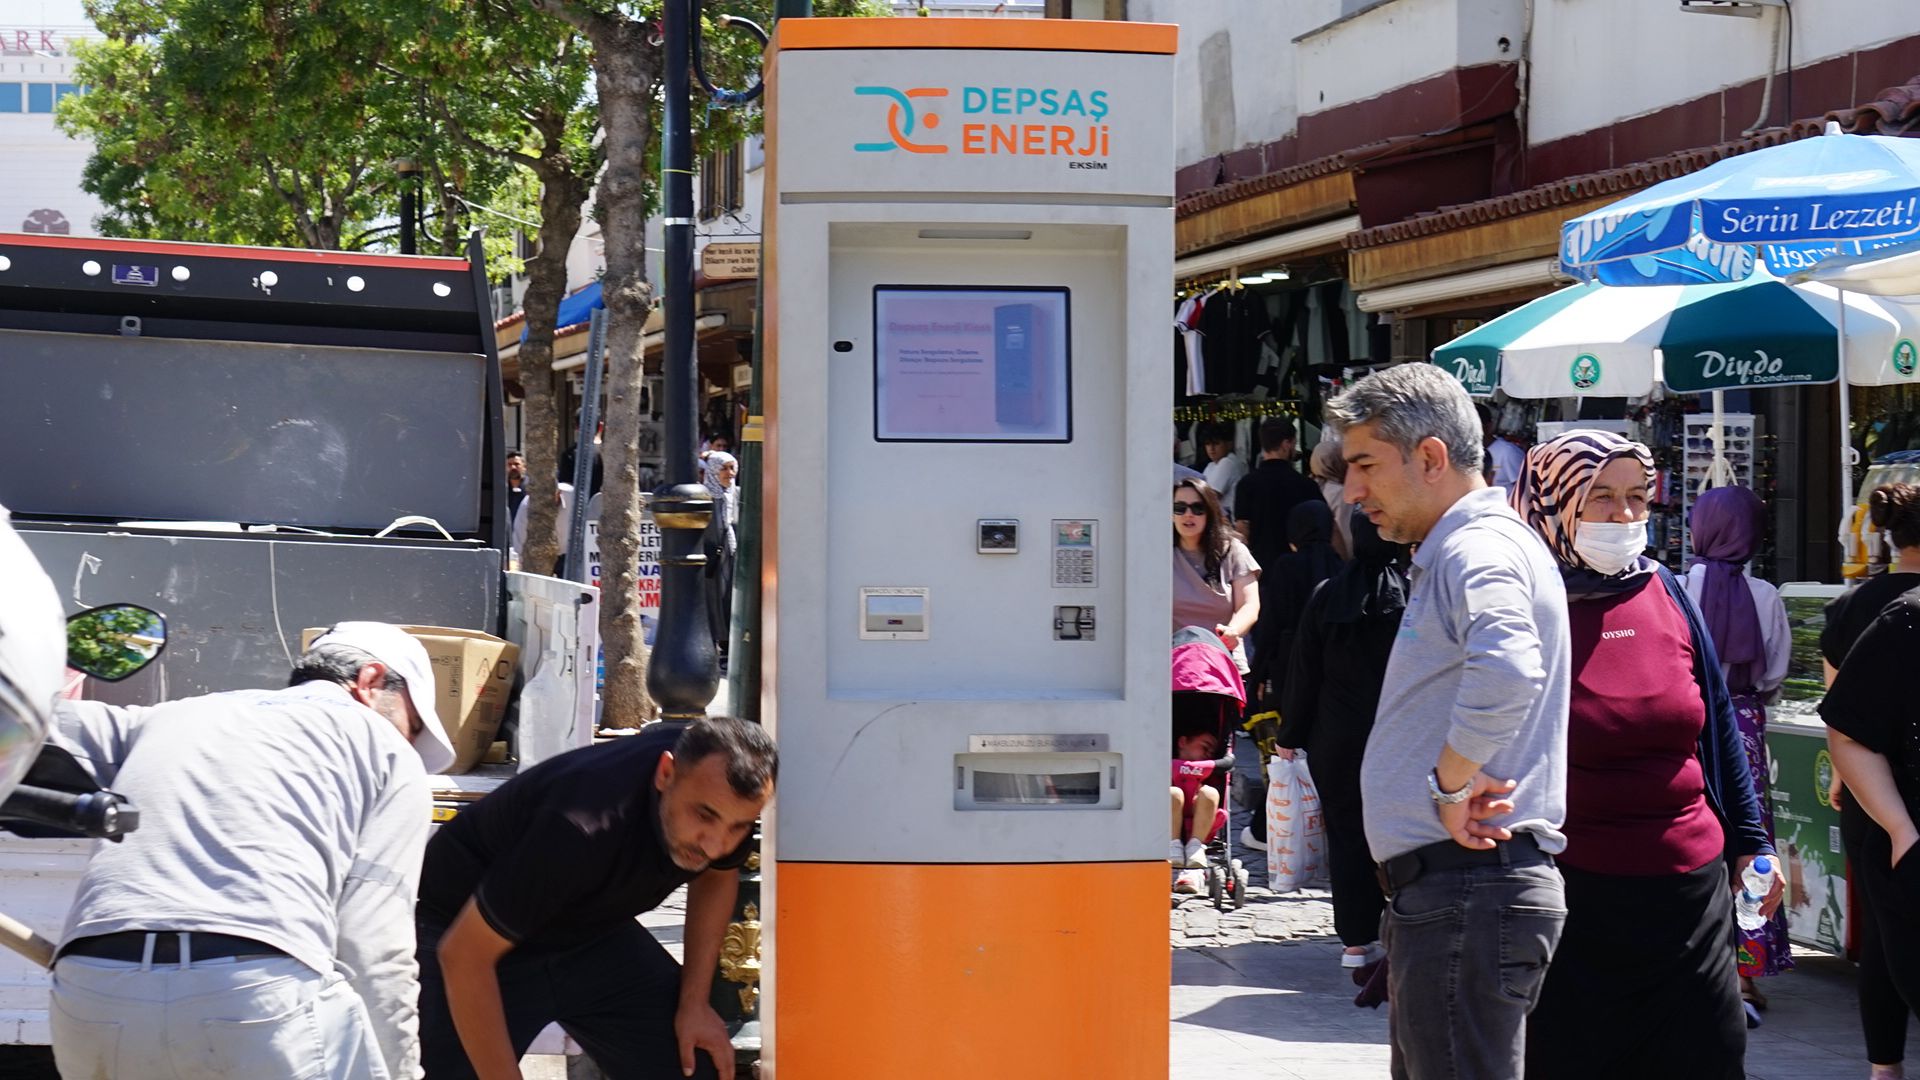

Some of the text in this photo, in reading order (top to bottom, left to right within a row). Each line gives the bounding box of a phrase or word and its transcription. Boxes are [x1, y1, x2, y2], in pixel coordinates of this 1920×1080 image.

[963, 87, 1109, 123] DEPSAŞ
[1721, 197, 1916, 235] Serin Lezzet!
[1602, 629, 1635, 639] OYSHO
